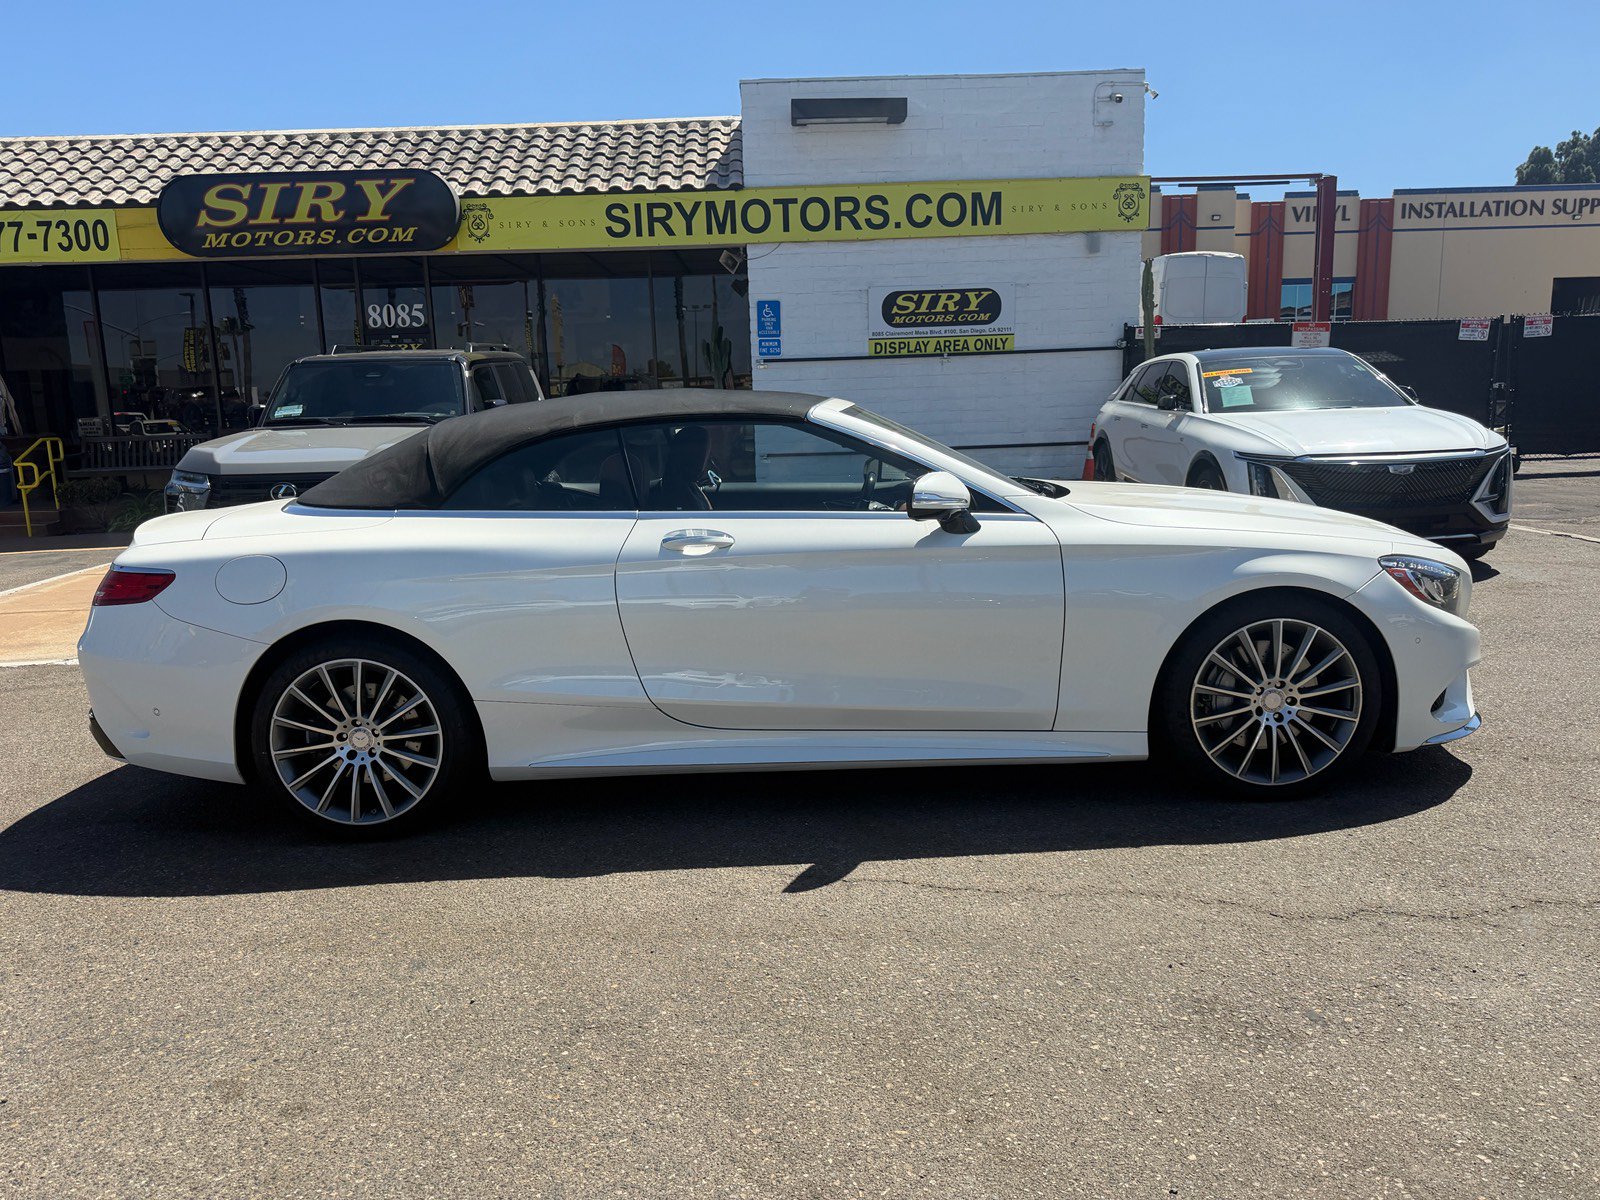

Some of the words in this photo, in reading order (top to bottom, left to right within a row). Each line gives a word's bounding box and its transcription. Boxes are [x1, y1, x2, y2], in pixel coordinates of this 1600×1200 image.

[197, 178, 415, 226] SIRY
[1011, 204, 1045, 213] SIRY
[1054, 204, 1061, 212] &
[1071, 202, 1108, 210] SONS
[1292, 205, 1350, 222] VIL
[1401, 199, 1544, 219] INSTALLATION
[500, 220, 531, 229] SIRY
[542, 220, 548, 228] &
[559, 218, 596, 228] SONS
[605, 190, 1002, 239] SIRYMOTORS.COM
[202, 227, 418, 248] MOTORS.COM
[891, 291, 993, 315] SIRY
[367, 303, 425, 328] 8085
[892, 312, 992, 325] MOTORS.COM
[874, 340, 930, 355] DISPLAY
[933, 338, 970, 353] AREA
[973, 337, 1009, 351] ONLY
